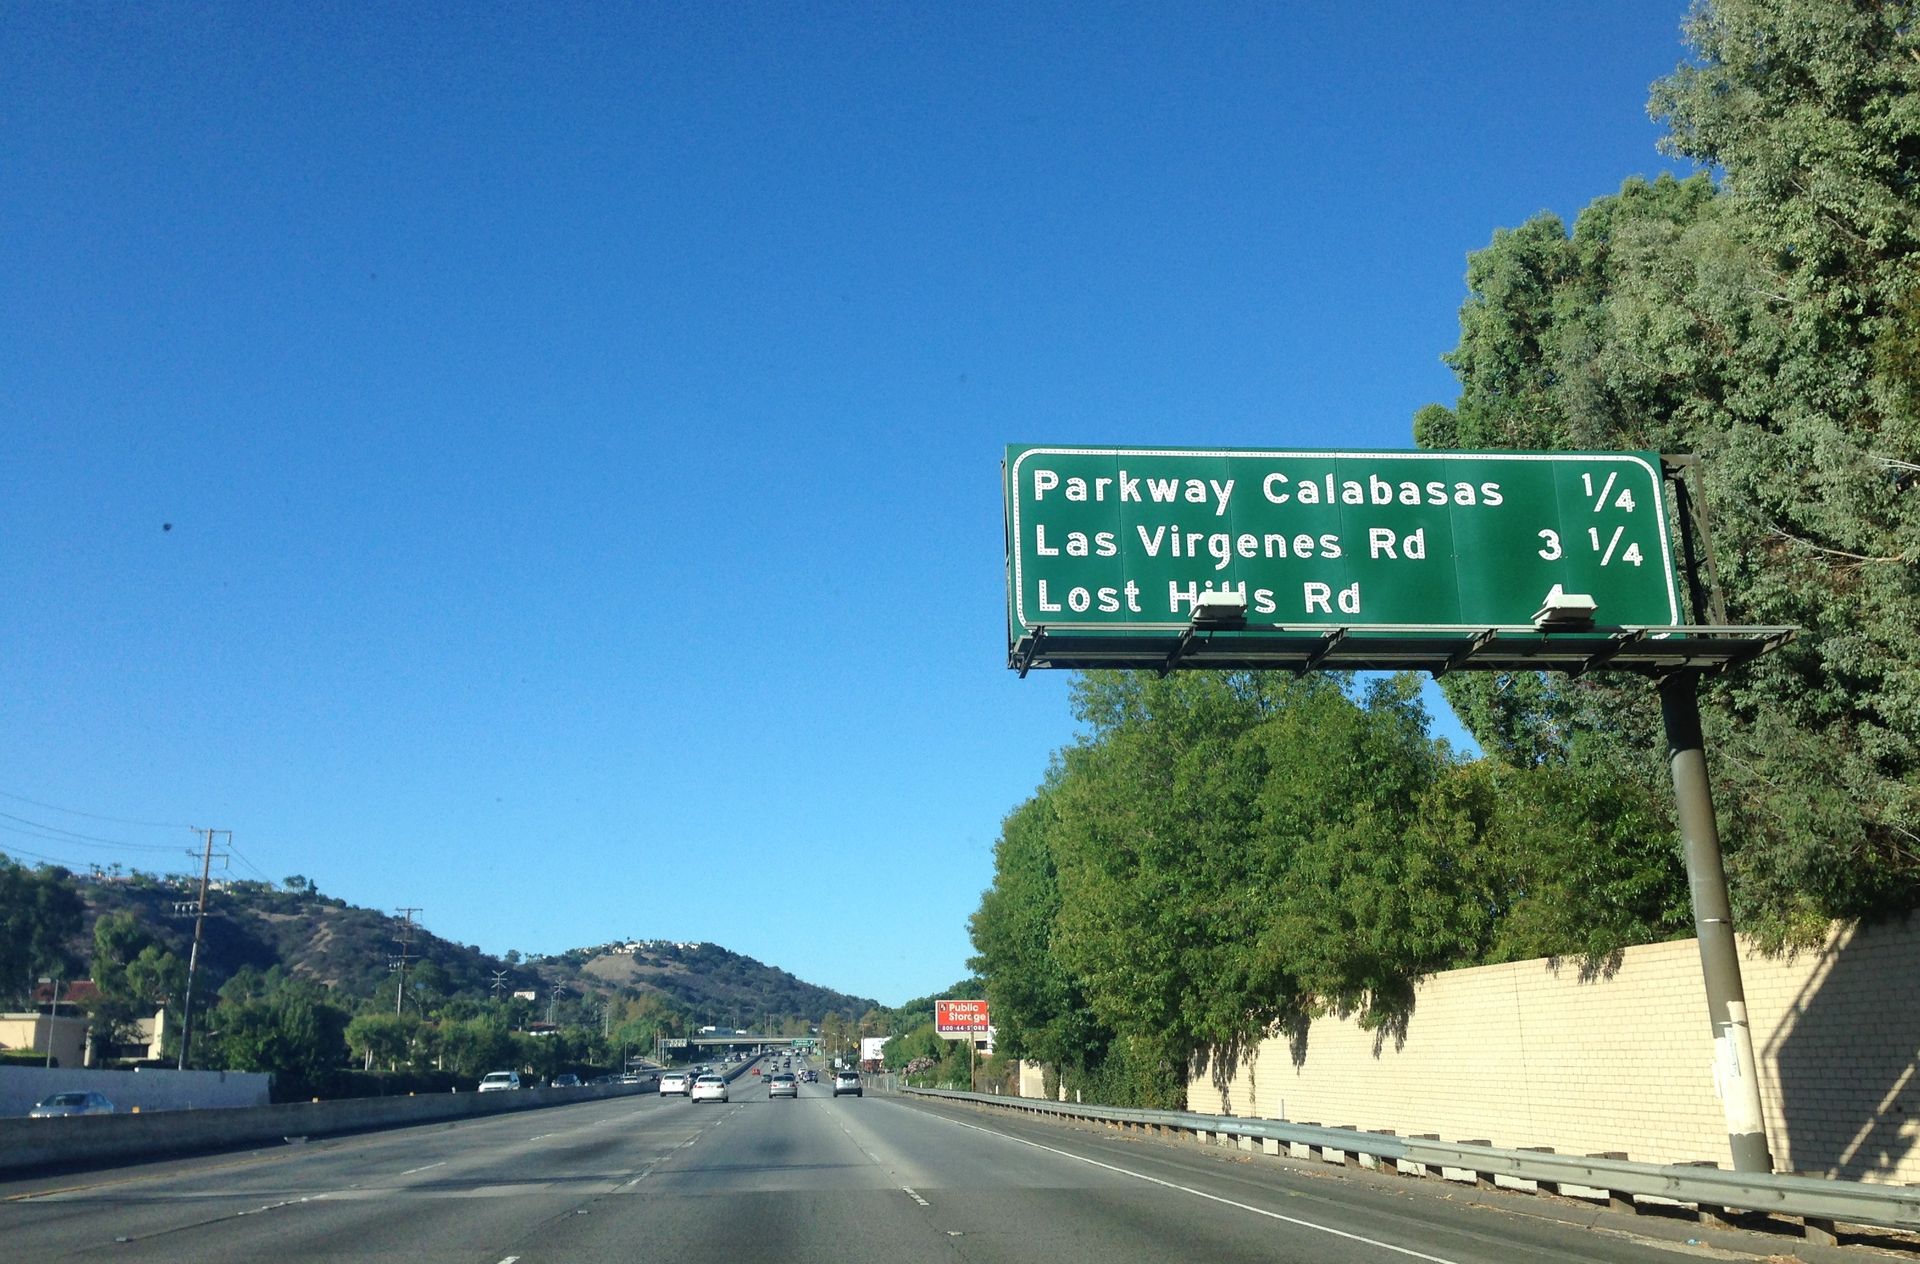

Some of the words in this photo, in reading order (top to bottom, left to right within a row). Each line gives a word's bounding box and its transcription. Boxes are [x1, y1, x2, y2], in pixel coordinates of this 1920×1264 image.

[1034, 469, 1235, 516] Parkway
[1263, 472, 1504, 506] Calabasas
[1036, 524, 1117, 557] Las
[1136, 525, 1342, 571] Virgenes
[1368, 527, 1426, 560] Rd
[1537, 528, 1562, 561] 3
[1038, 579, 1142, 613] Lost
[1303, 581, 1361, 614] Rd
[949, 1003, 979, 1012] Public
